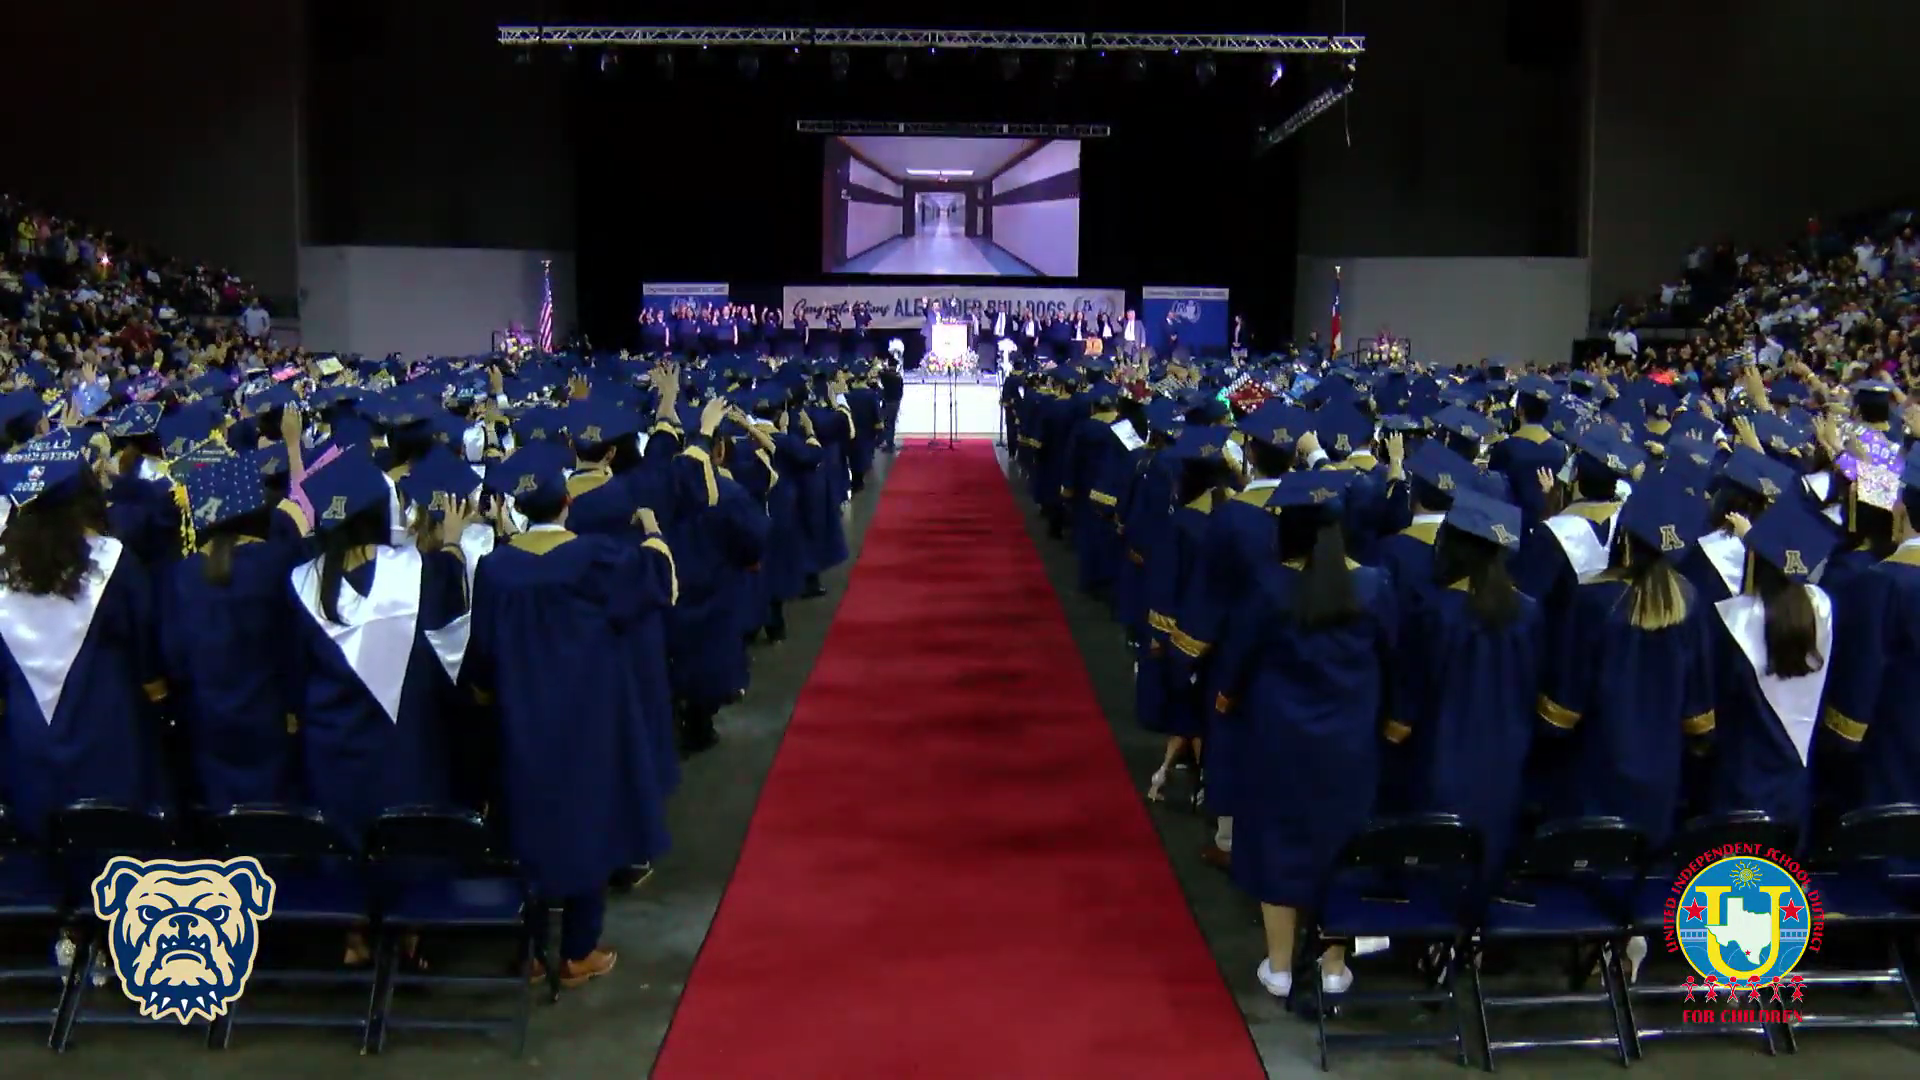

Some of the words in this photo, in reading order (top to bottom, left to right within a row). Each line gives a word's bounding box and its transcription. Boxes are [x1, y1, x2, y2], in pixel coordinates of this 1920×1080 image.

[322, 495, 347, 520] A
[1659, 524, 1685, 551] A
[1784, 549, 1809, 574] A
